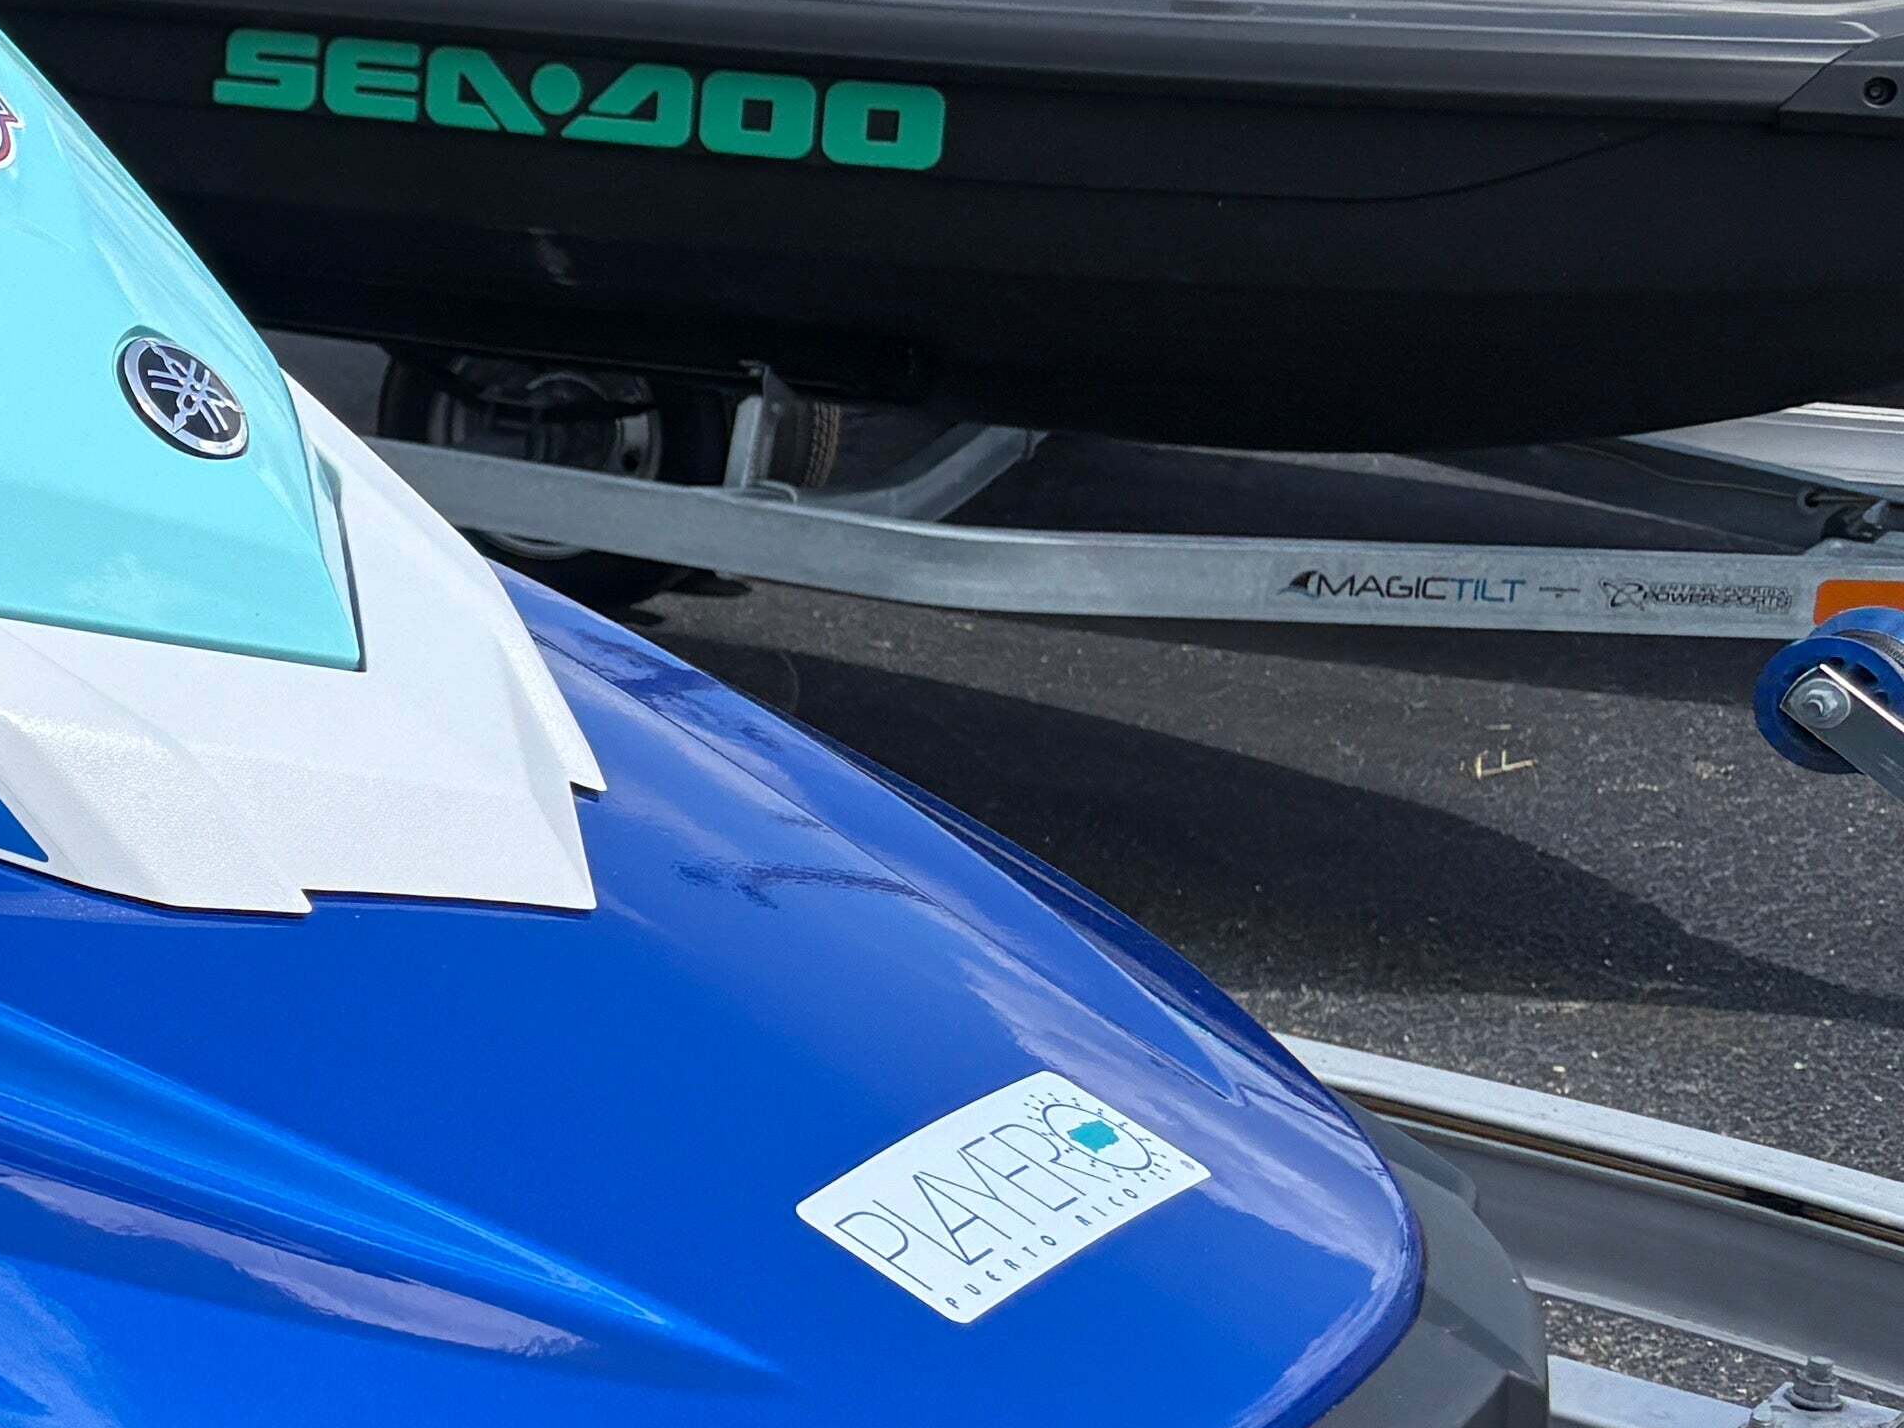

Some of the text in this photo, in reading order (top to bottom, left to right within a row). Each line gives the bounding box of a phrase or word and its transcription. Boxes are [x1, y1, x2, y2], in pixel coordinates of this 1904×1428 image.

[1316, 573, 1527, 603] MAGICTILT
[945, 1188, 1139, 1309] PUERTO RICO
